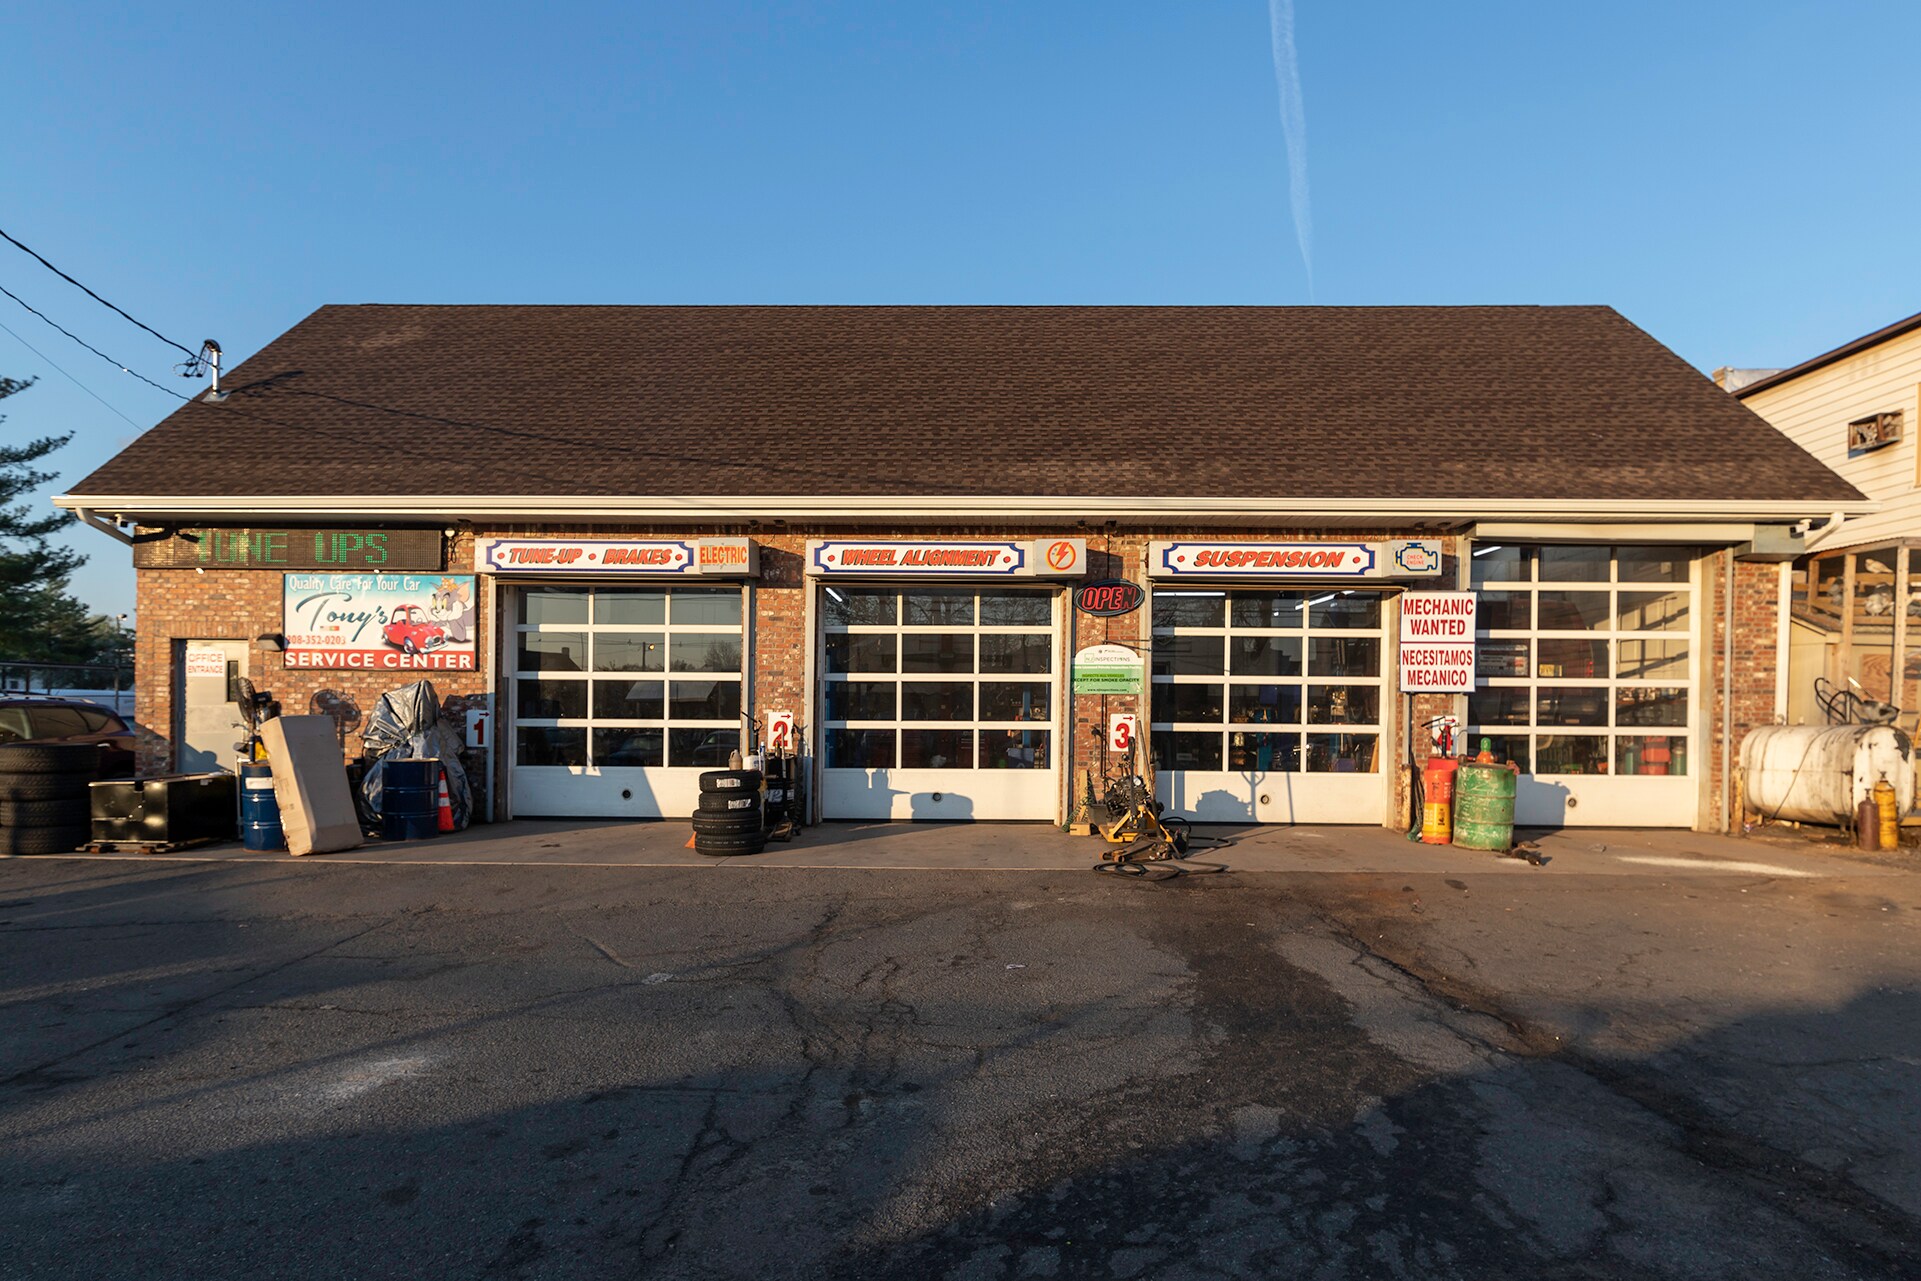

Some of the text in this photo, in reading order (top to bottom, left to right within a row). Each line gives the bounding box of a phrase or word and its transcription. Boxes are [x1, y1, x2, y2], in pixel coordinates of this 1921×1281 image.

[192, 532, 388, 563] TUNE UPS
[508, 547, 672, 565] TUNE-UP BRAKES
[699, 546, 748, 564] ELECTRIC
[840, 549, 1001, 567] WHEEL ALIGNMENT
[1193, 550, 1346, 568] SUSPENSION
[289, 576, 421, 591] Quality Care For Your Car
[1081, 586, 1137, 610] OPEN
[1403, 598, 1474, 616] MECHANIC
[295, 592, 389, 643] Tony's
[1410, 619, 1466, 635] WANTED
[188, 653, 223, 663] OFFICE
[285, 652, 472, 668] SERVICE CENTER
[1402, 649, 1473, 666] NECESITAMOS
[188, 665, 223, 674] ENTRANCE
[1407, 669, 1467, 686] MECANICO
[474, 719, 484, 745] 1
[773, 721, 788, 747] 2
[1115, 723, 1130, 749] 3
[1437, 725, 1453, 751] 4
